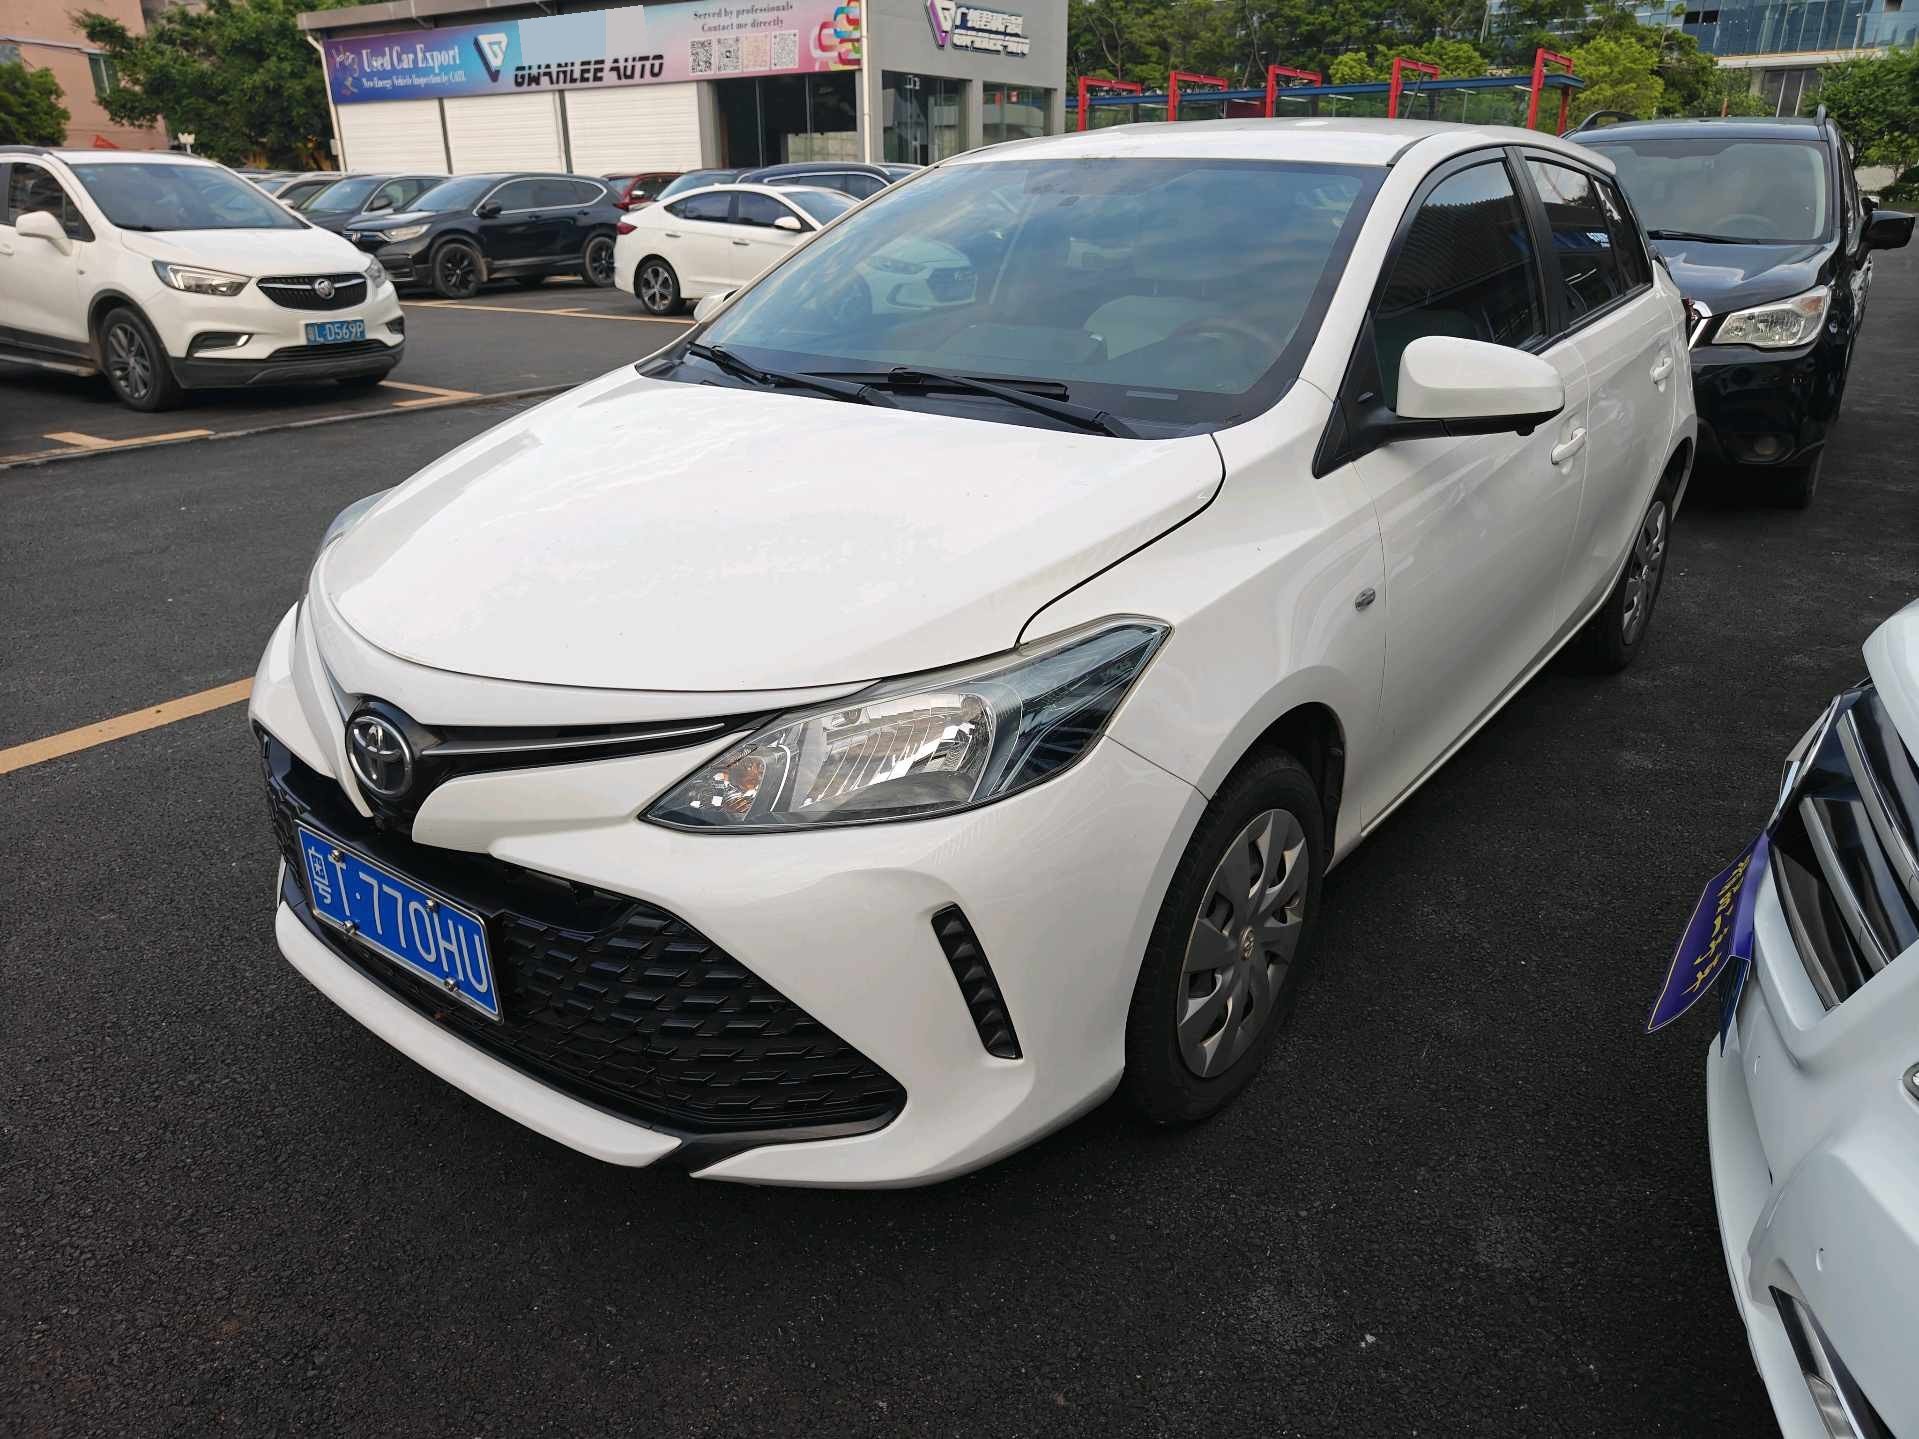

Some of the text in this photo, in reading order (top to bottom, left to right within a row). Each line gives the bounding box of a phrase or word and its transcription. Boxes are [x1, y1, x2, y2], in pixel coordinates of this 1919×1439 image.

[694, 1, 793, 19] Served by professionals
[702, 16, 784, 32] Contact me directly
[362, 46, 391, 72] Used
[392, 45, 415, 70] Car
[416, 43, 460, 73] Export
[514, 54, 664, 88] GWANLEE AUTO
